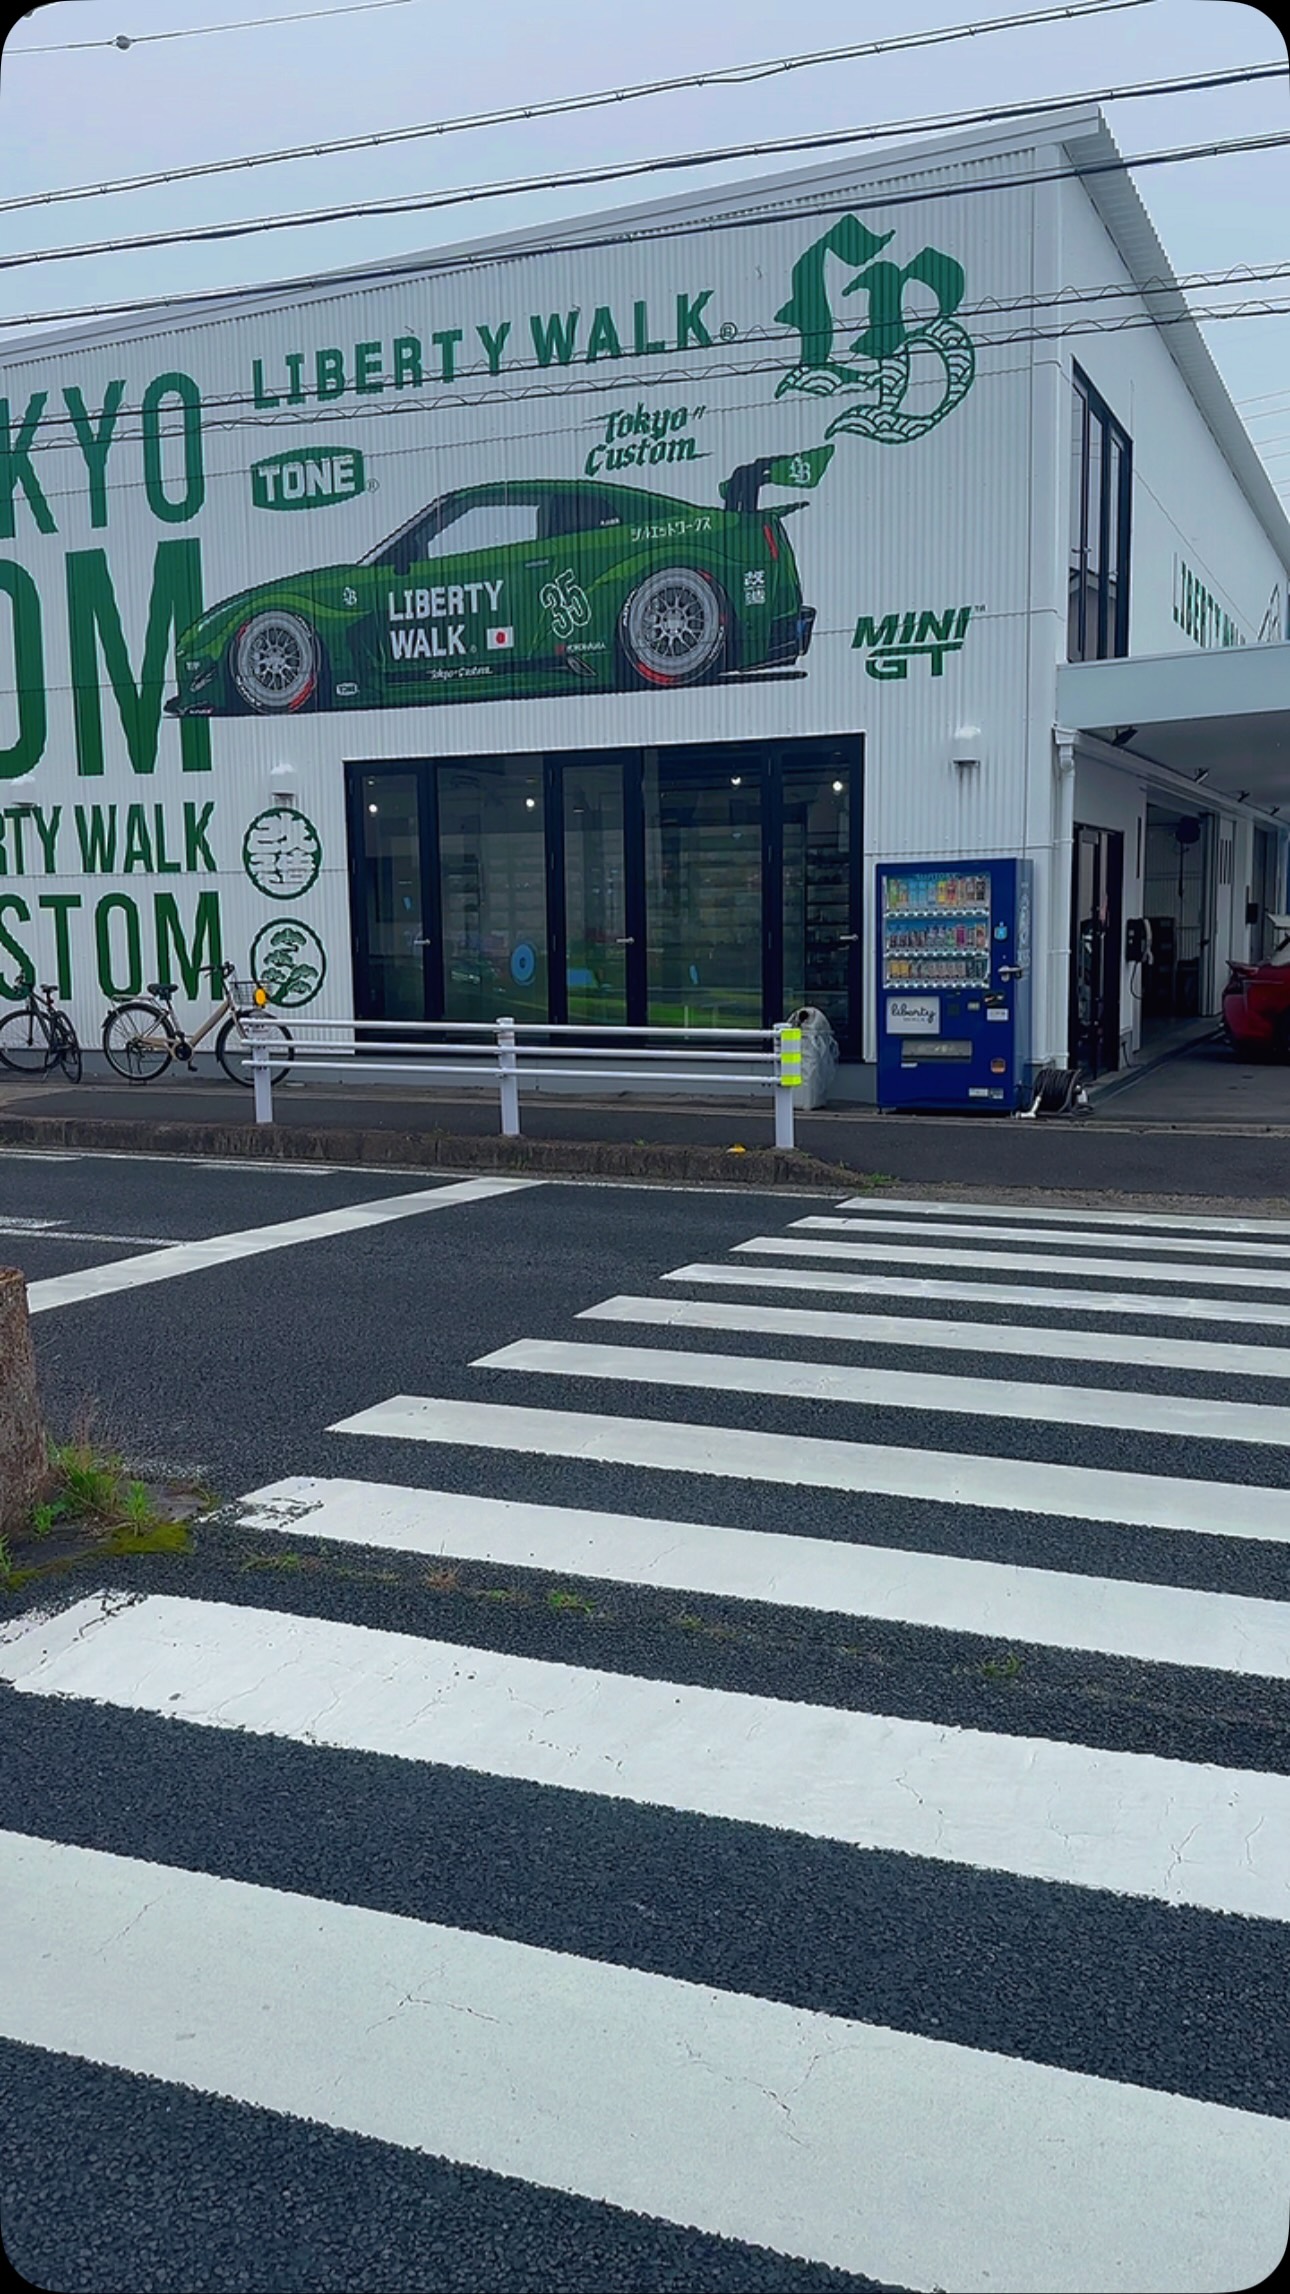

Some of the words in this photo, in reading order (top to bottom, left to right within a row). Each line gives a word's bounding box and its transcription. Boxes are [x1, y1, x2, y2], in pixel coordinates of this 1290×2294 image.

[252, 321, 511, 409] LIBERTY
[530, 290, 714, 367] WALK
[582, 402, 706, 444] Tokyo
[0, 372, 205, 538] KYO
[585, 437, 713, 477] Custom
[258, 454, 356, 502] TONE
[388, 580, 504, 621] LIBERTY
[540, 568, 592, 639] 35
[390, 624, 467, 660] WALK
[851, 605, 972, 649] MINI
[864, 641, 964, 680] GT
[73, 801, 217, 873] WALK
[0, 891, 224, 1001] STOM
[891, 1002, 936, 1024] liberty
